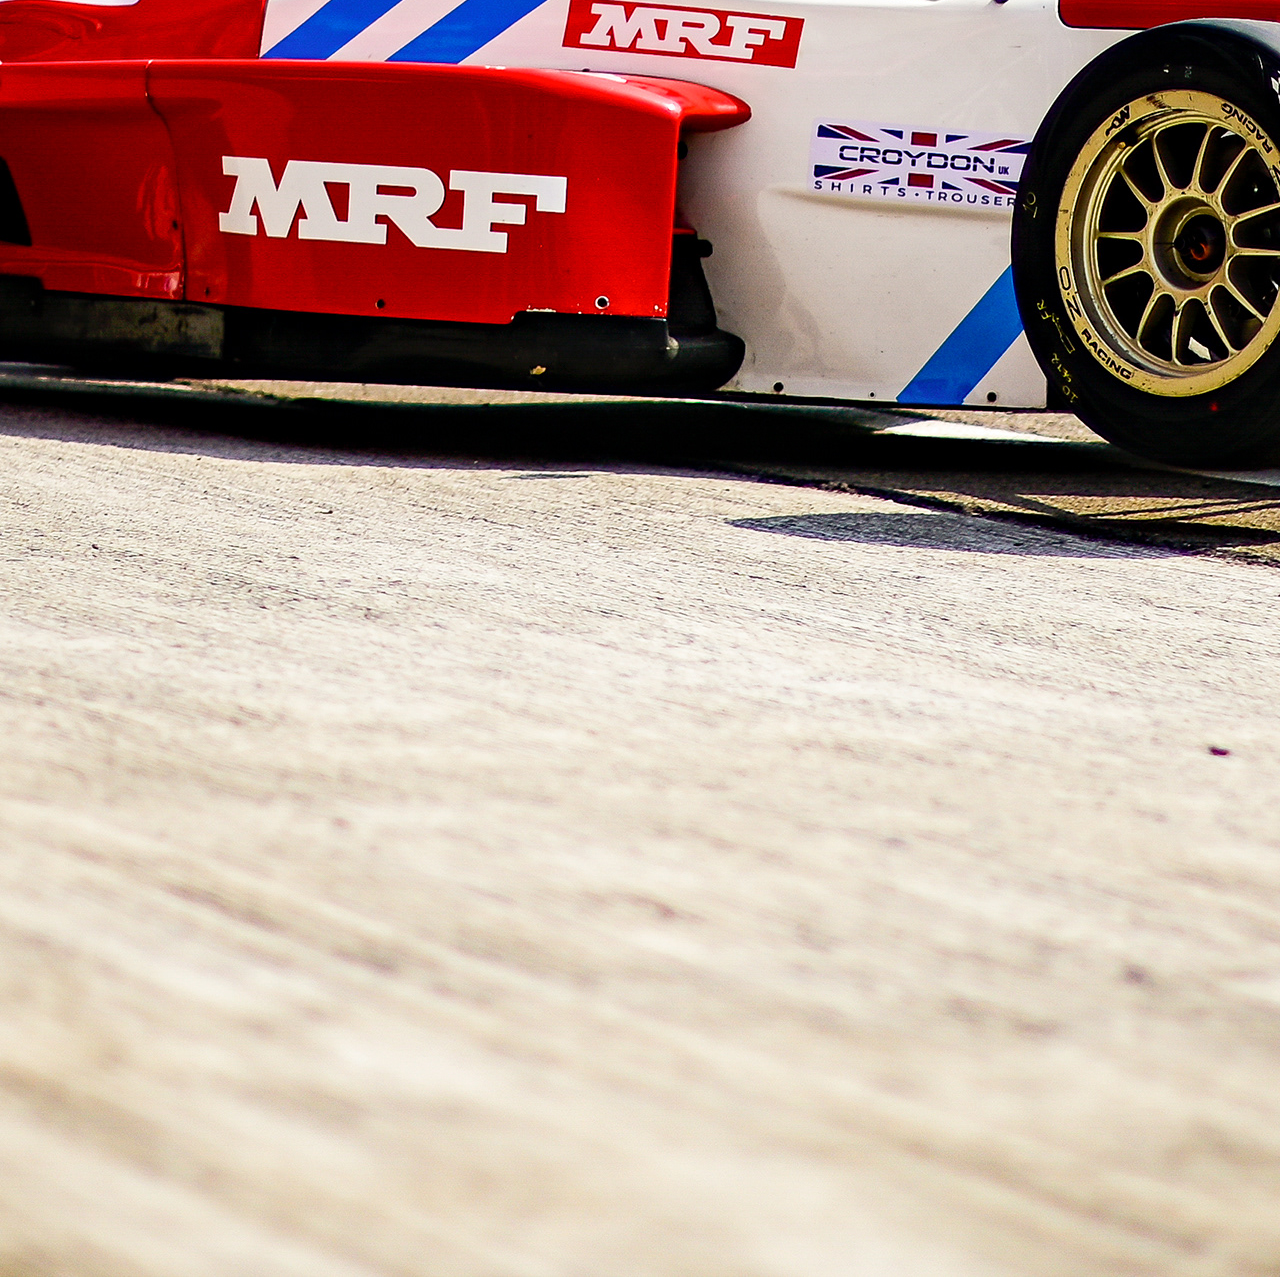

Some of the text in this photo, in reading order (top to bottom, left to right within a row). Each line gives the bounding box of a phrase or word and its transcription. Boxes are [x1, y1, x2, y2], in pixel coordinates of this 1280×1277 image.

[579, 2, 787, 60] MRF
[1221, 102, 1273, 154] RACING
[839, 145, 1010, 176] CROYDON UK
[219, 156, 567, 253] MRF
[814, 180, 906, 197] SHIRTS
[1081, 328, 1135, 380] RACING
